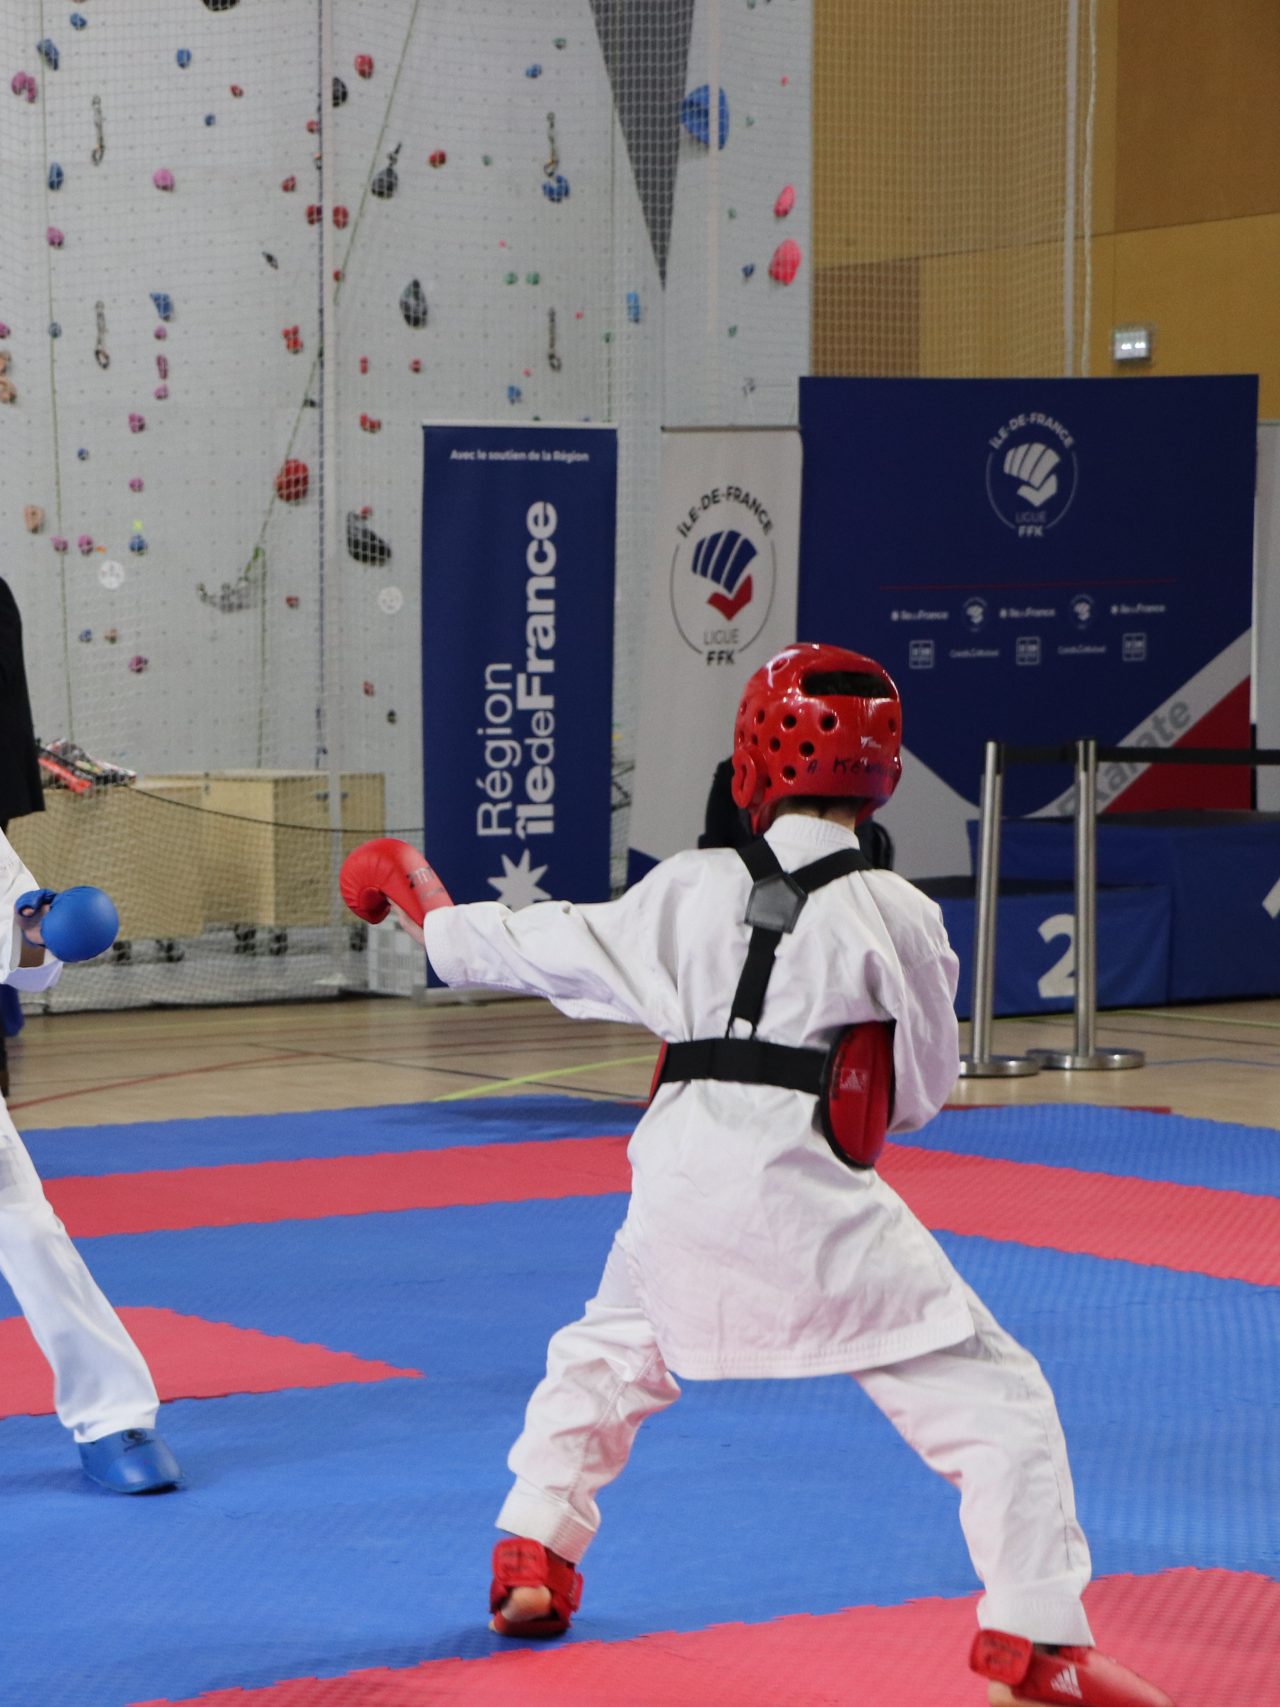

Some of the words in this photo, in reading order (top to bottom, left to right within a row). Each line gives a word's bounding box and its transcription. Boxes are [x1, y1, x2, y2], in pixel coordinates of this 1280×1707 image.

[450, 448, 476, 460] Avec
[477, 448, 488, 460] le
[488, 448, 527, 461] soutien
[528, 449, 541, 461] de
[541, 449, 552, 461] la
[553, 449, 589, 464] Région
[1018, 524, 1043, 537] FFK
[703, 628, 740, 646] LIGUE
[707, 650, 736, 667] FFK
[476, 662, 522, 837] Région
[1037, 913, 1077, 998] 2
